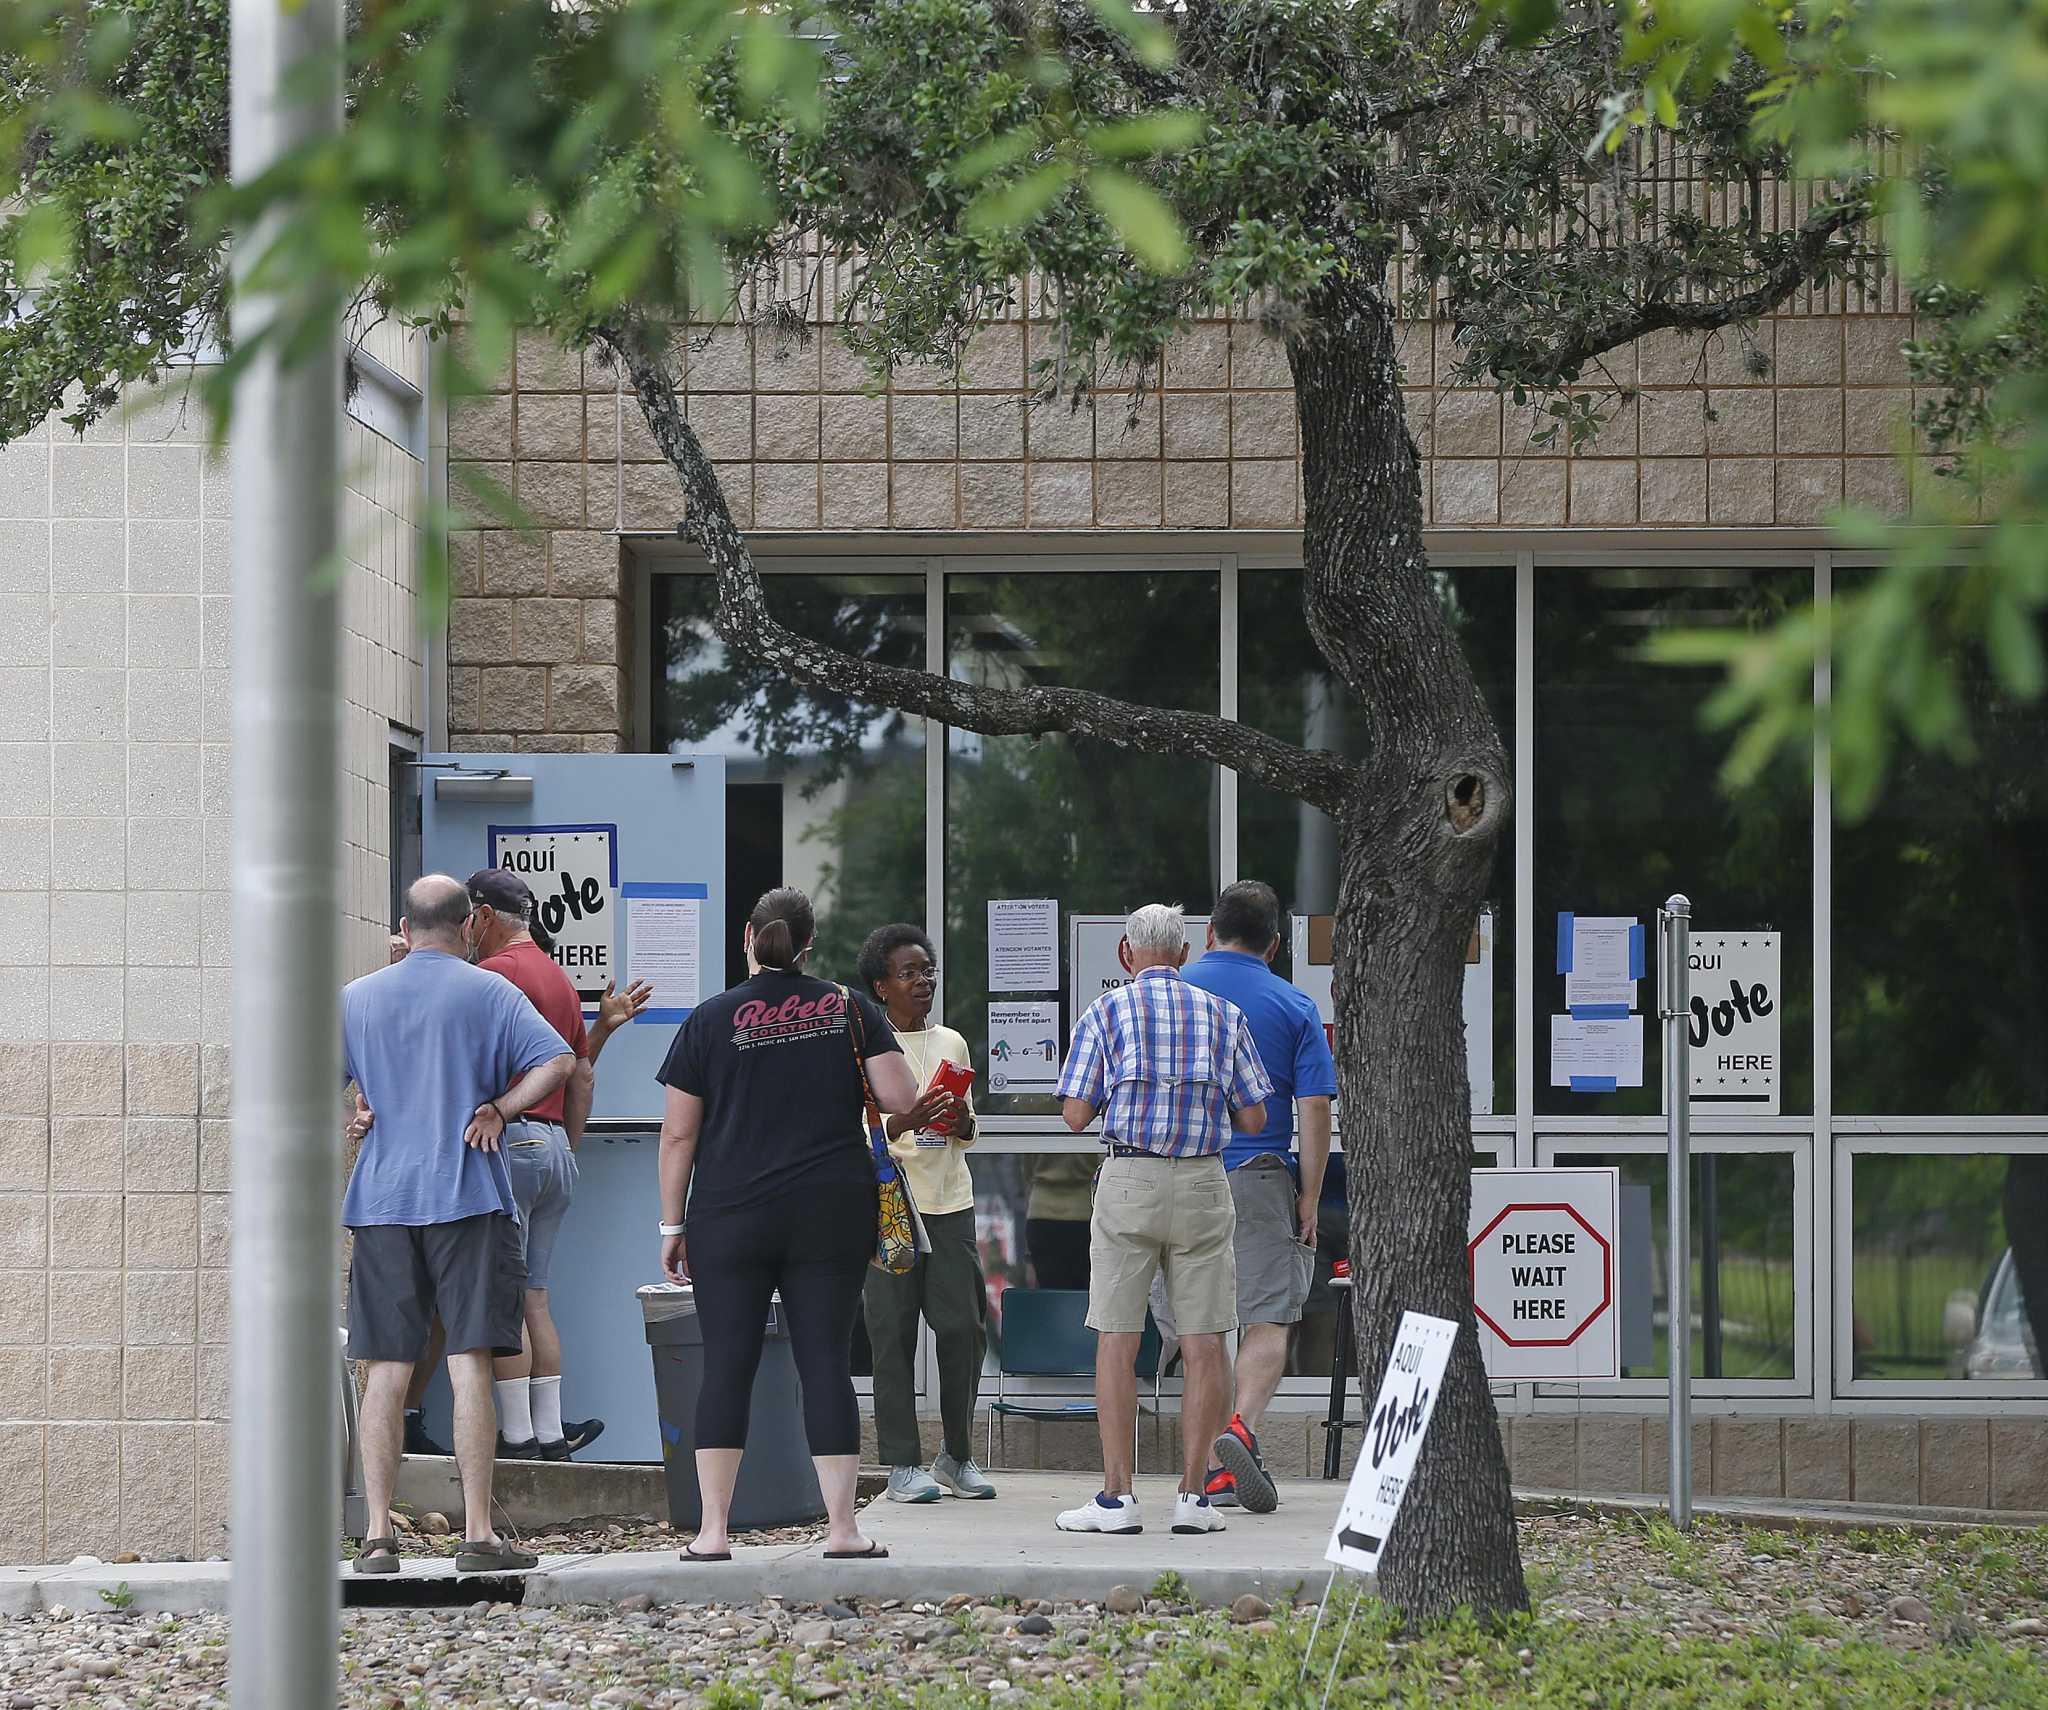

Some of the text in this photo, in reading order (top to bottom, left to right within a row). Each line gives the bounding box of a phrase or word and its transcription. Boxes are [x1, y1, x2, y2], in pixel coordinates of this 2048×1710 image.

[502, 845, 555, 873] AQUÍ
[551, 945, 607, 966] HERE
[1688, 954, 1721, 970] QUI
[1101, 979, 1120, 988] NO
[750, 1018, 833, 1038] COCKTAILS
[1718, 1055, 1773, 1070] HERE
[1502, 1233, 1576, 1255] PLEASE
[1511, 1266, 1567, 1287] WAIT
[1513, 1299, 1566, 1320] HERE
[1372, 1377, 1429, 1470] Vote
[1376, 1474, 1404, 1507] HERE
